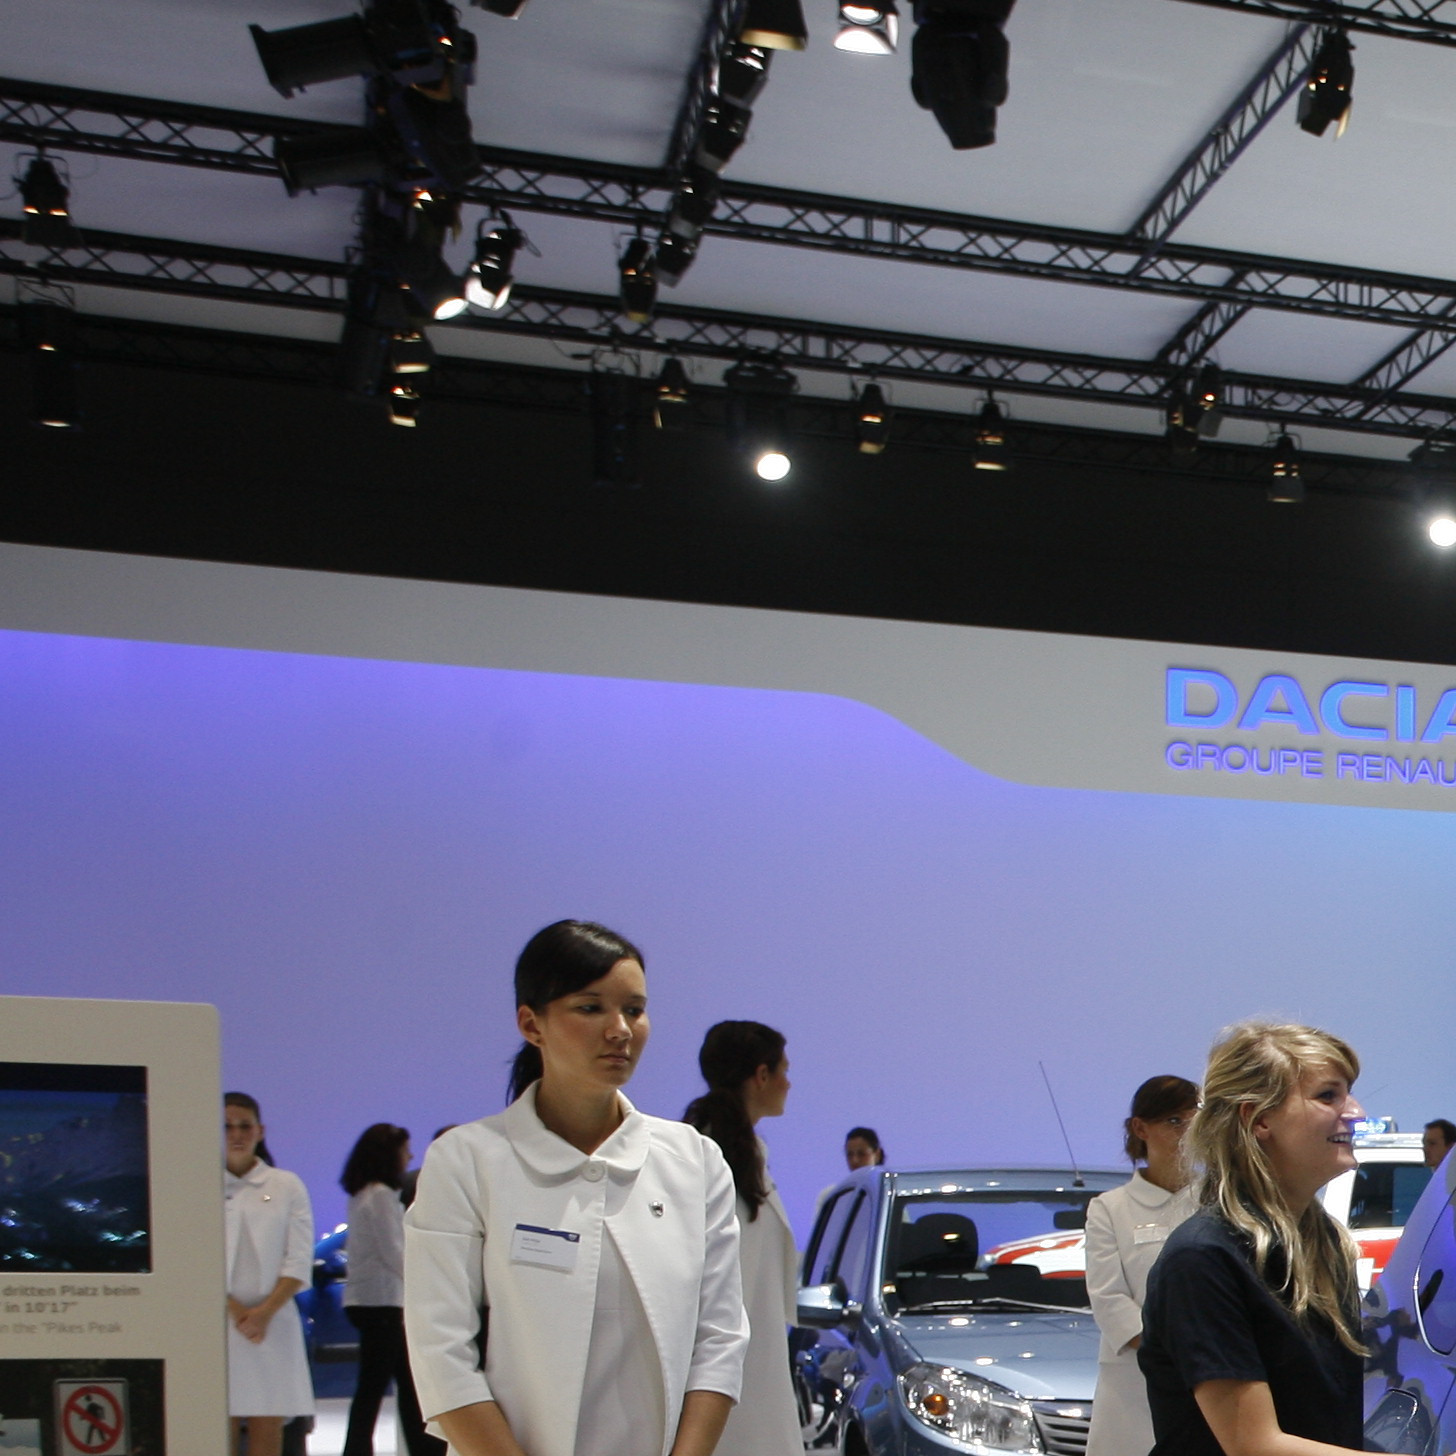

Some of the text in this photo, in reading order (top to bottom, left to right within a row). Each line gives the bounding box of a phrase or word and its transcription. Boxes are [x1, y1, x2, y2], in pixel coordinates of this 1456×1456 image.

[1164, 741, 1324, 779] GROUPE
[2, 1284, 141, 1296] dritten Platz beim
